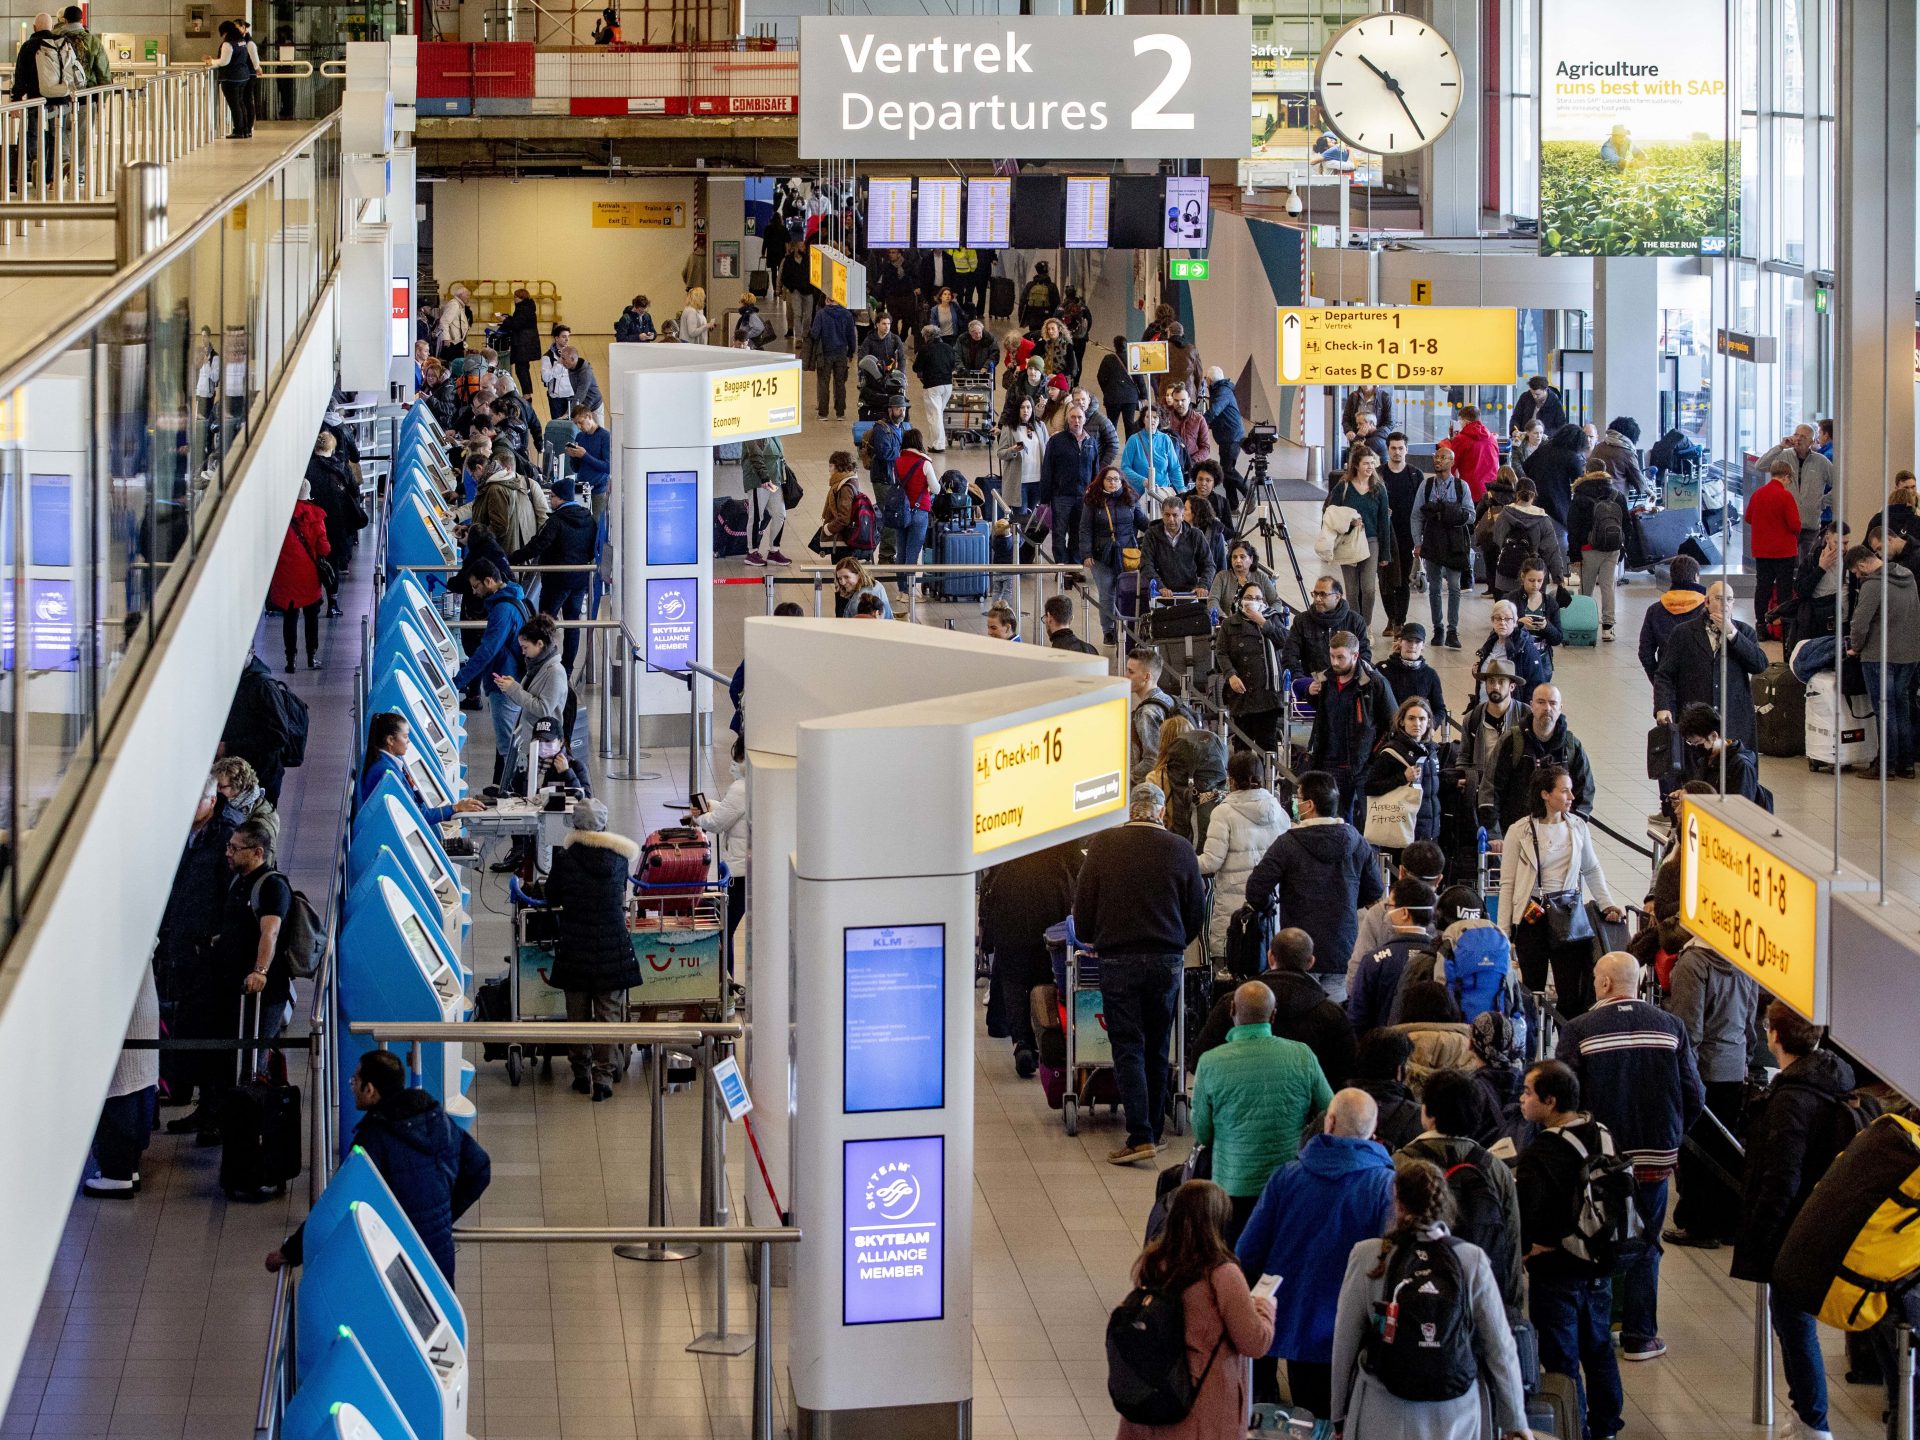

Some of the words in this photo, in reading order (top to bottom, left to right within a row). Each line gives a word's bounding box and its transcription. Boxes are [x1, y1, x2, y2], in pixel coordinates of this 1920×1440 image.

[839, 32, 1033, 73] Vertrek
[1251, 44, 1293, 58] Safety
[1281, 57, 1308, 70] best
[1556, 61, 1659, 80] Agriculture
[1131, 33, 1195, 130] 2
[1556, 81, 1596, 95] runs
[1600, 80, 1640, 95] best
[1644, 80, 1683, 95] with
[732, 98, 787, 111] COMBISAFE
[842, 92, 1108, 140] Departures
[1643, 241, 1659, 249] THE
[1660, 241, 1680, 249] BEST
[1681, 241, 1698, 249] RUN
[1702, 239, 1727, 251] SAP
[1416, 284, 1426, 302] F
[1325, 311, 1388, 322] Departures
[1392, 313, 1400, 329] 1
[1325, 340, 1373, 351] Check-in
[1377, 338, 1399, 354] 1a
[1409, 338, 1438, 354] 1-8
[1325, 365, 1357, 376] Gates
[1361, 363, 1372, 379] B
[1376, 363, 1389, 379] C
[1397, 363, 1411, 379] D
[1413, 366, 1444, 376] 59-87
[724, 380, 750, 393] Baggage
[752, 377, 777, 398] 12-15
[713, 416, 741, 428] Economy
[657, 590, 680, 615] SKYTEAM
[652, 626, 691, 634] SKYTEAM
[655, 643, 688, 651] MEMBER
[995, 741, 1040, 771] Check-in
[1044, 727, 1062, 765] 16
[975, 806, 1024, 834] Economy
[1372, 815, 1407, 825] Fitness
[1712, 838, 1743, 877] Check-in
[1745, 853, 1760, 899] 1a
[1767, 867, 1787, 916] 1-8
[1457, 905, 1480, 920] VANS
[873, 938, 902, 947] KLM
[1711, 901, 1732, 935] Gates
[1733, 909, 1741, 950] B
[1743, 918, 1752, 960] C
[1757, 926, 1767, 967] D
[1767, 940, 1790, 975] 59-87
[679, 957, 700, 968] TUI
[1373, 948, 1392, 963] HH
[865, 1162, 910, 1210] SKYTEAM
[855, 1232, 930, 1248] SKYTEAM
[857, 1248, 928, 1264] ALLIANCE
[860, 1264, 924, 1280] MEMBER
